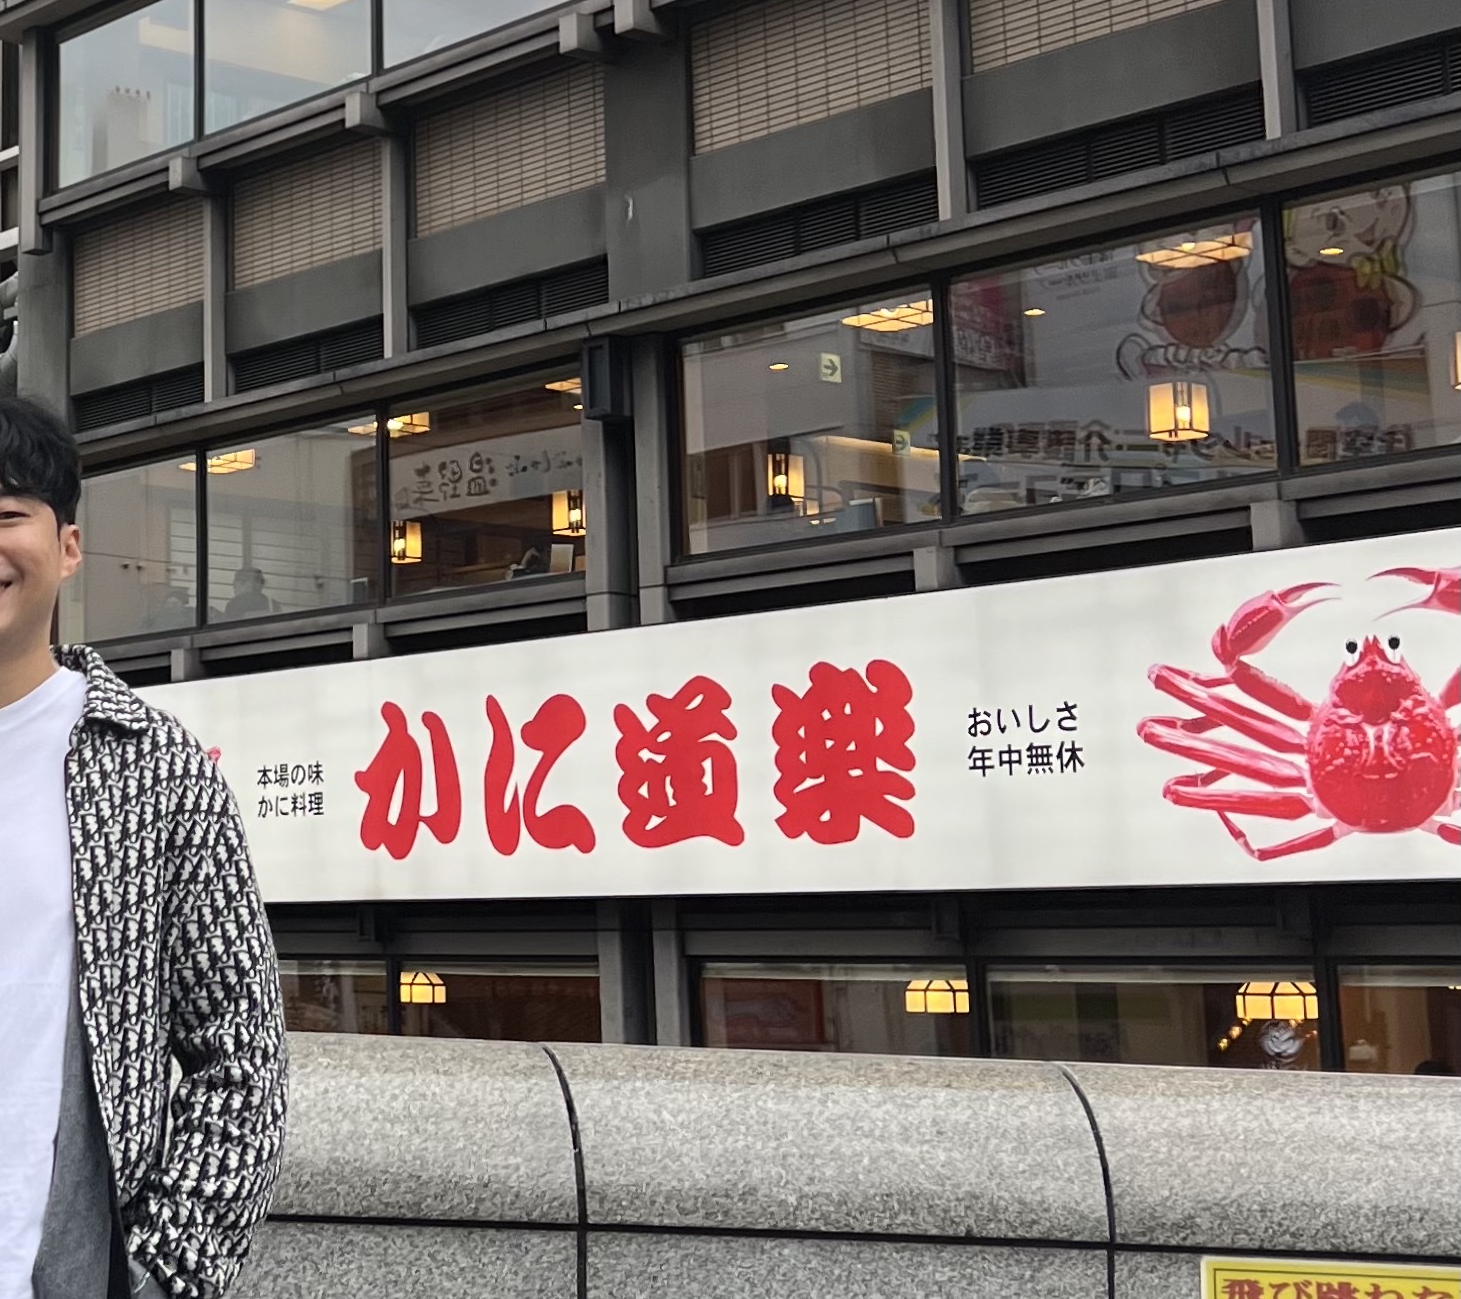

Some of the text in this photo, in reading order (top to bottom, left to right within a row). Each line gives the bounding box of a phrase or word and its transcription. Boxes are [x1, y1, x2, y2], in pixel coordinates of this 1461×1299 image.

[966, 701, 1080, 738] おいしさ
[257, 760, 324, 789] 本場の味
[966, 740, 1085, 778] 年中無休
[257, 791, 325, 819] かに料理
